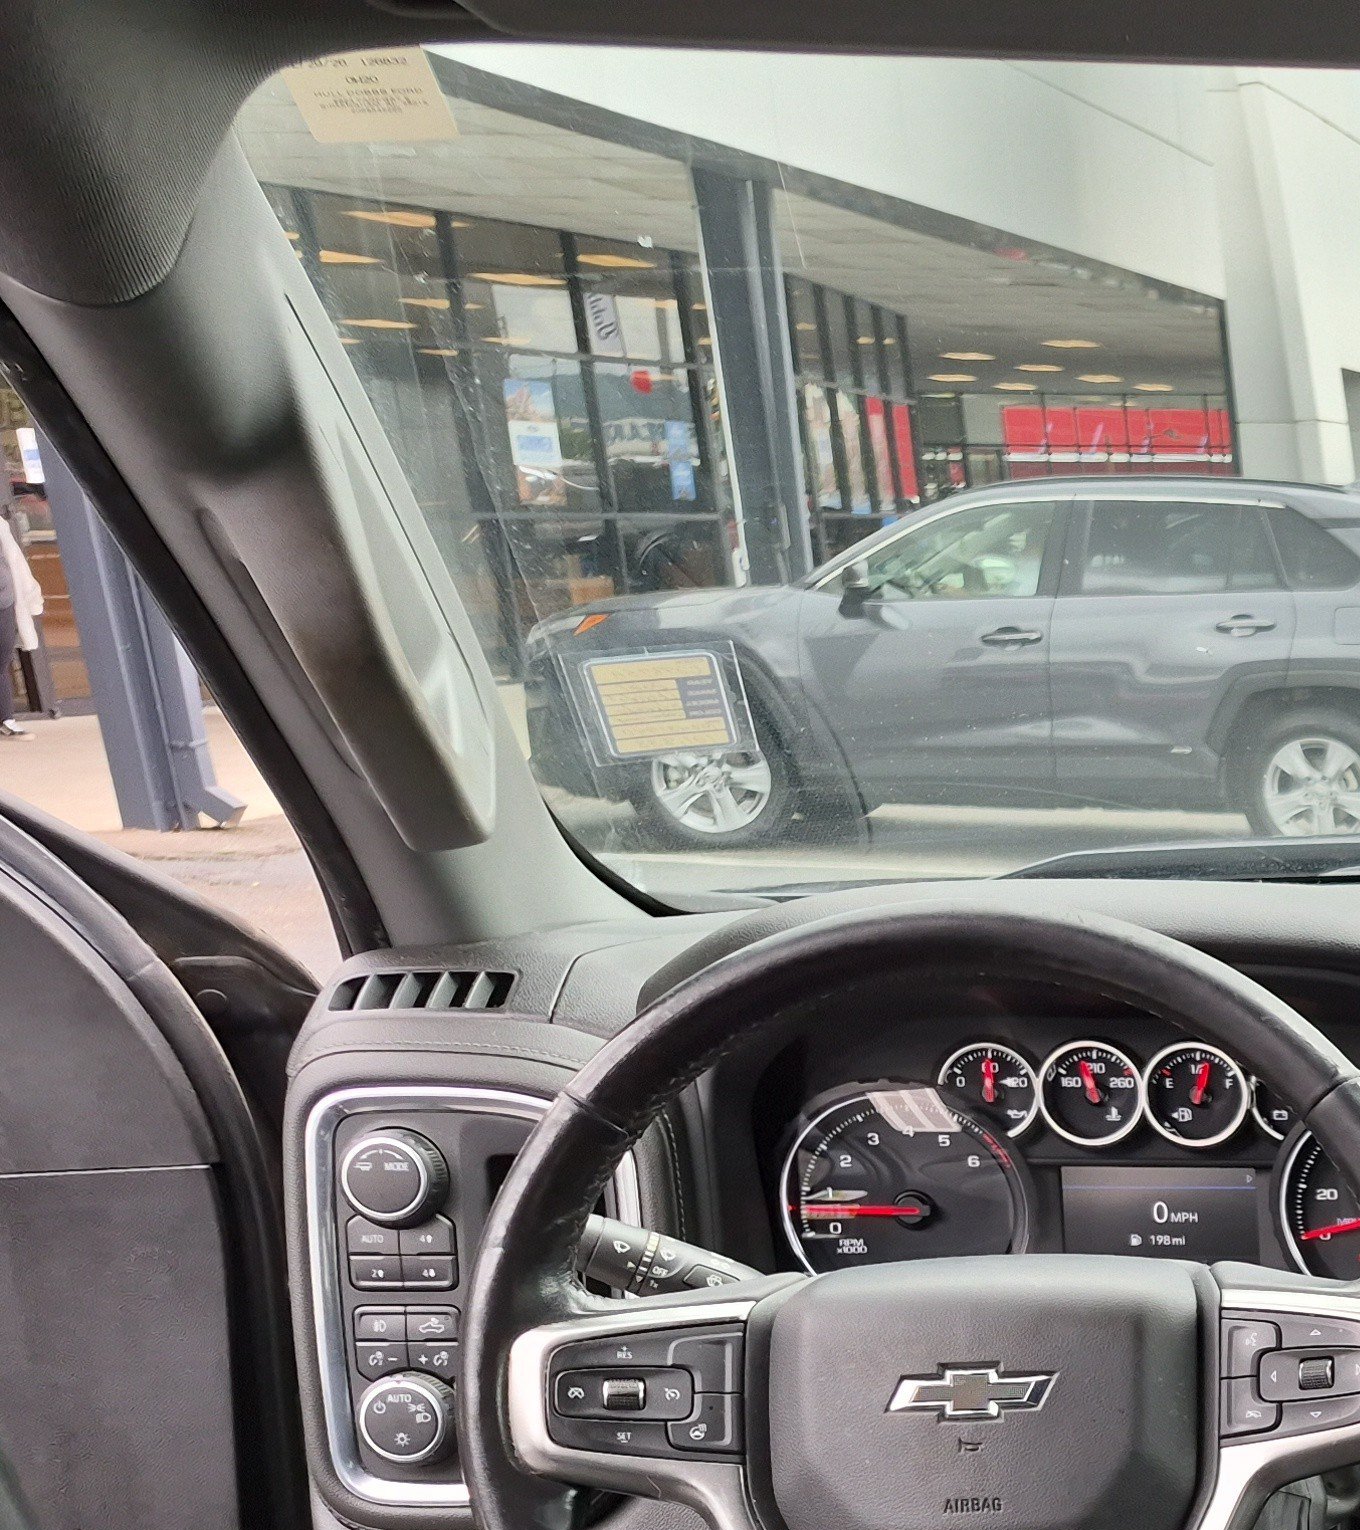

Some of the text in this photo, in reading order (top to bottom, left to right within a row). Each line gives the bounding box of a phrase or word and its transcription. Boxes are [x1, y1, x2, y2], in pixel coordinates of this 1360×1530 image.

[1086, 1063, 1105, 1073] 210
[1061, 1077, 1081, 1088] 160
[1109, 1077, 1134, 1088] 260
[1165, 1078, 1174, 1088] E
[1225, 1078, 1233, 1089] F
[902, 1125, 915, 1137] 4
[867, 1133, 880, 1145] 3
[938, 1135, 950, 1147] 5
[384, 1162, 409, 1171] MODE
[839, 1155, 852, 1168] 2
[968, 1156, 980, 1168] 6
[1316, 1188, 1338, 1200] 20
[1153, 1201, 1199, 1224] 0 MPH
[829, 1222, 842, 1234] 0
[361, 1235, 384, 1243] AUTO
[652, 1265, 669, 1277] OFF
[387, 1394, 412, 1403] AUTO
[944, 1496, 1003, 1514] AIRBAG
